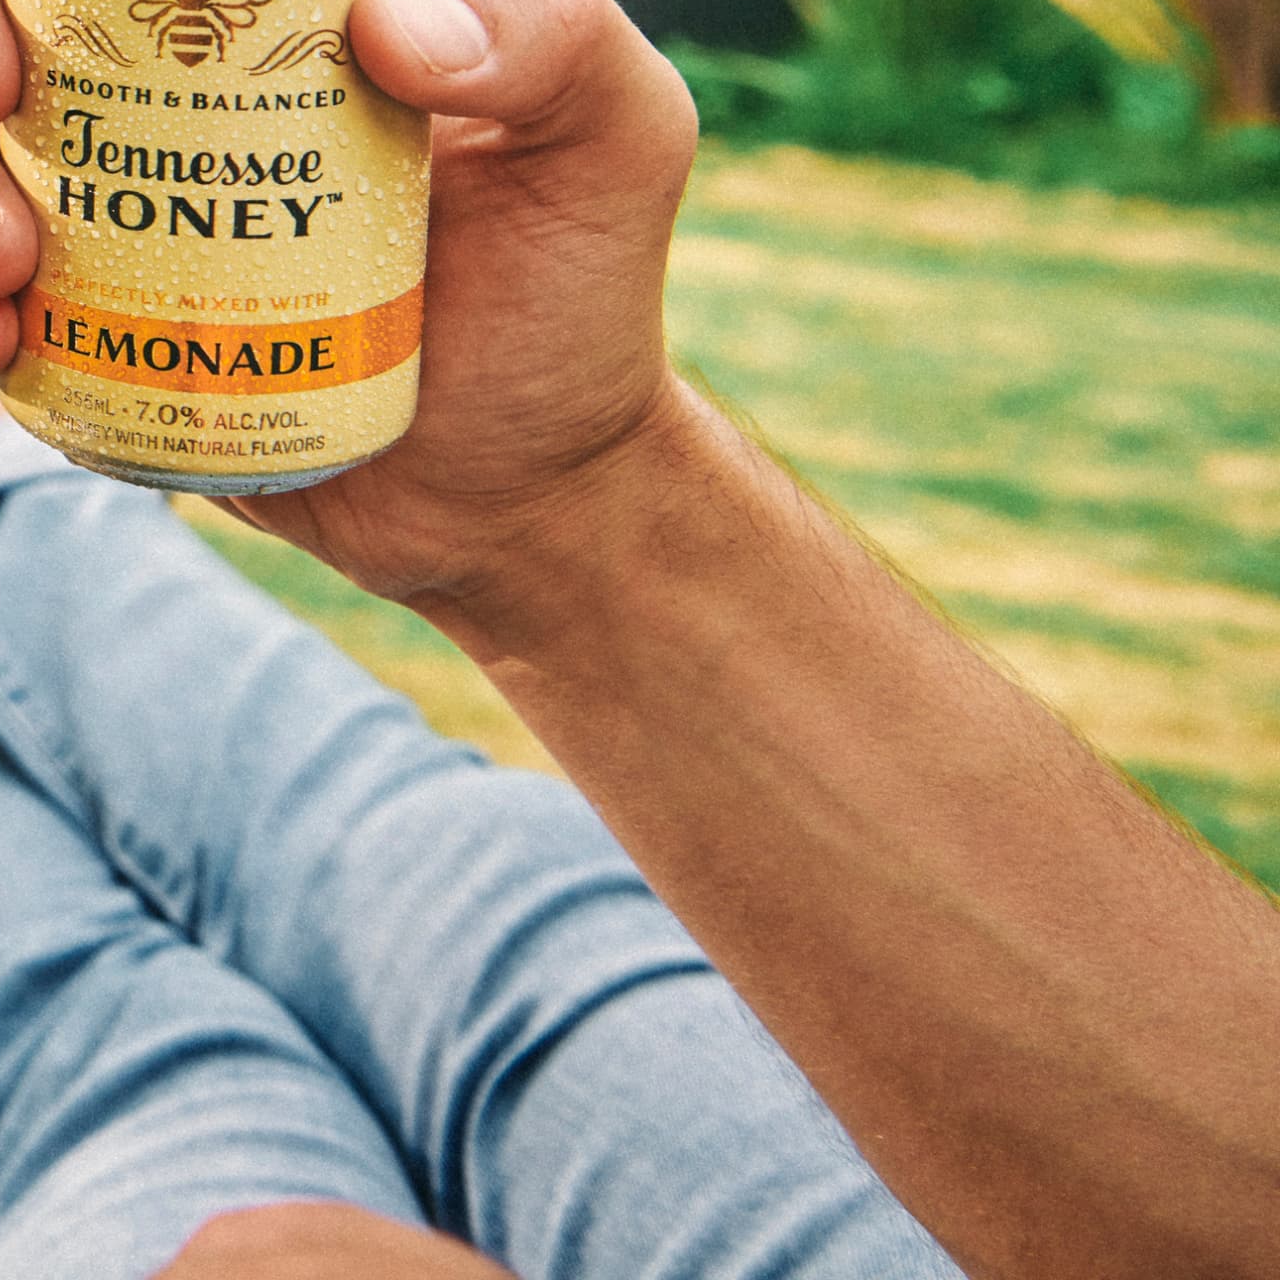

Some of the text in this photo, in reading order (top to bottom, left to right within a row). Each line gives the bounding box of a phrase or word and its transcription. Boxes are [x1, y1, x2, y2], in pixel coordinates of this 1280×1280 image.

[46, 69, 347, 112] SMOOTH & BALANCED
[60, 109, 324, 186] Tennessee
[51, 269, 330, 313] PERFECTLY MIXED WITH
[42, 309, 336, 377] LEMONADE
[135, 399, 206, 430] 7.0%
[213, 410, 309, 432] ALC./VOL.
[115, 427, 158, 451] WITH
[163, 435, 250, 458] NATURAL
[250, 434, 326, 457] FLAVORS
